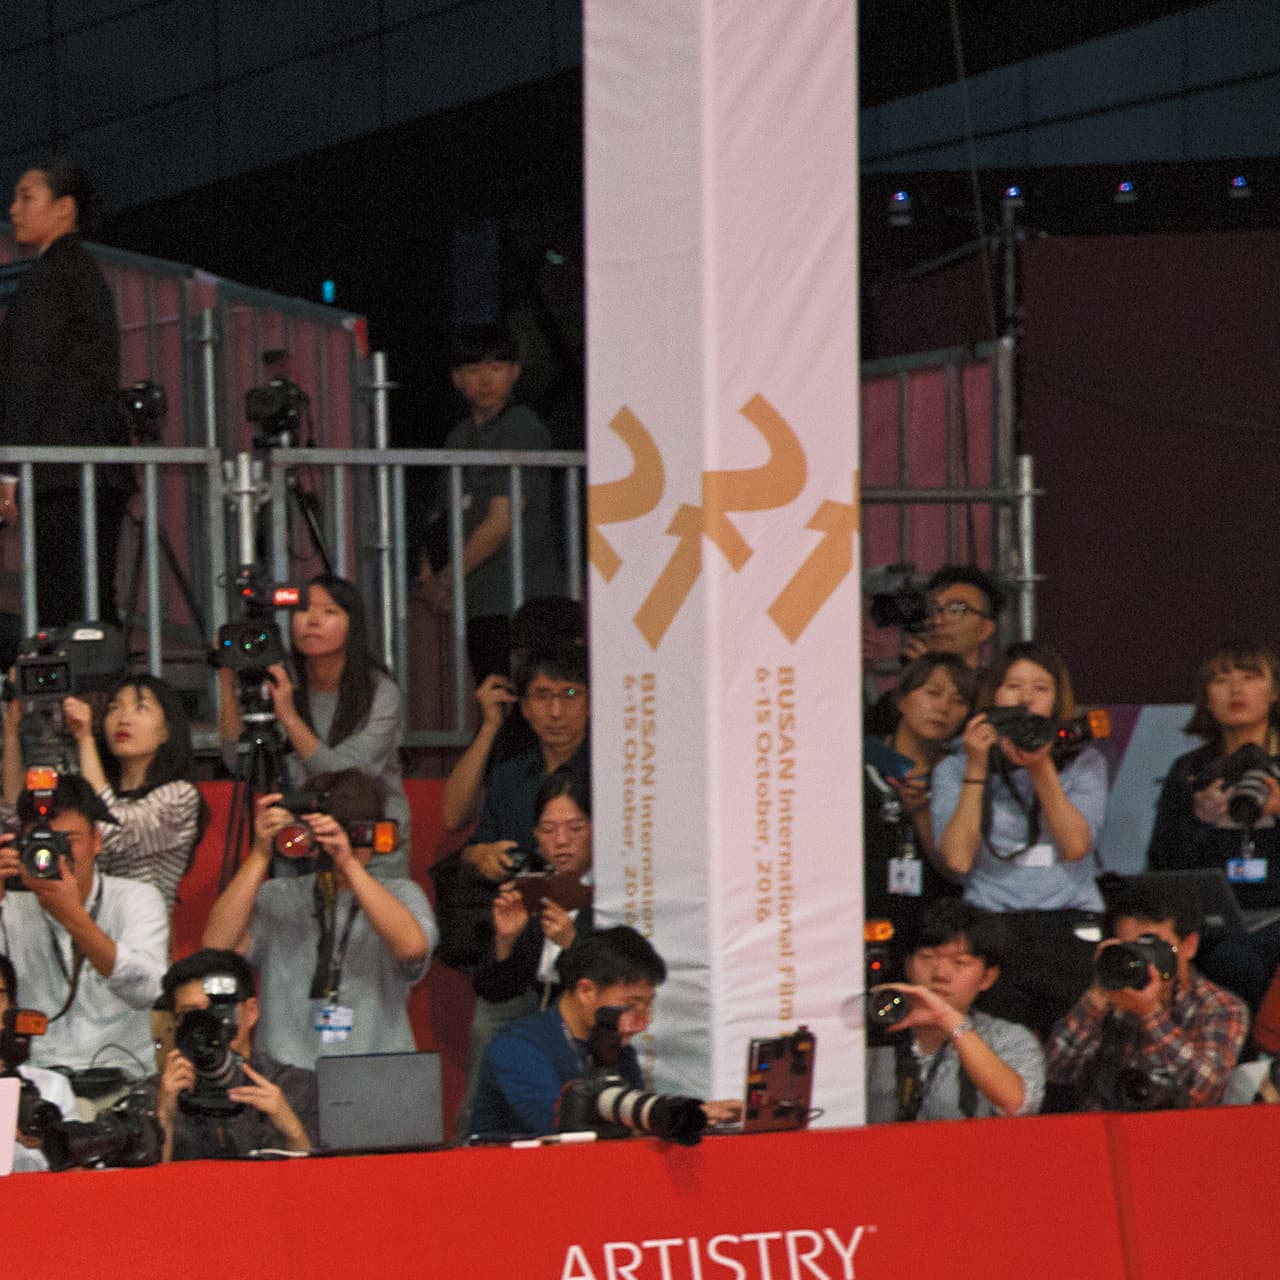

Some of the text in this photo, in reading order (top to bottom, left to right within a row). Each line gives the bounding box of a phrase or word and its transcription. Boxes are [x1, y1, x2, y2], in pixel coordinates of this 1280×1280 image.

[641, 672, 656, 786] BUSAN
[777, 665, 795, 780] BUSAN
[777, 788, 795, 957] International
